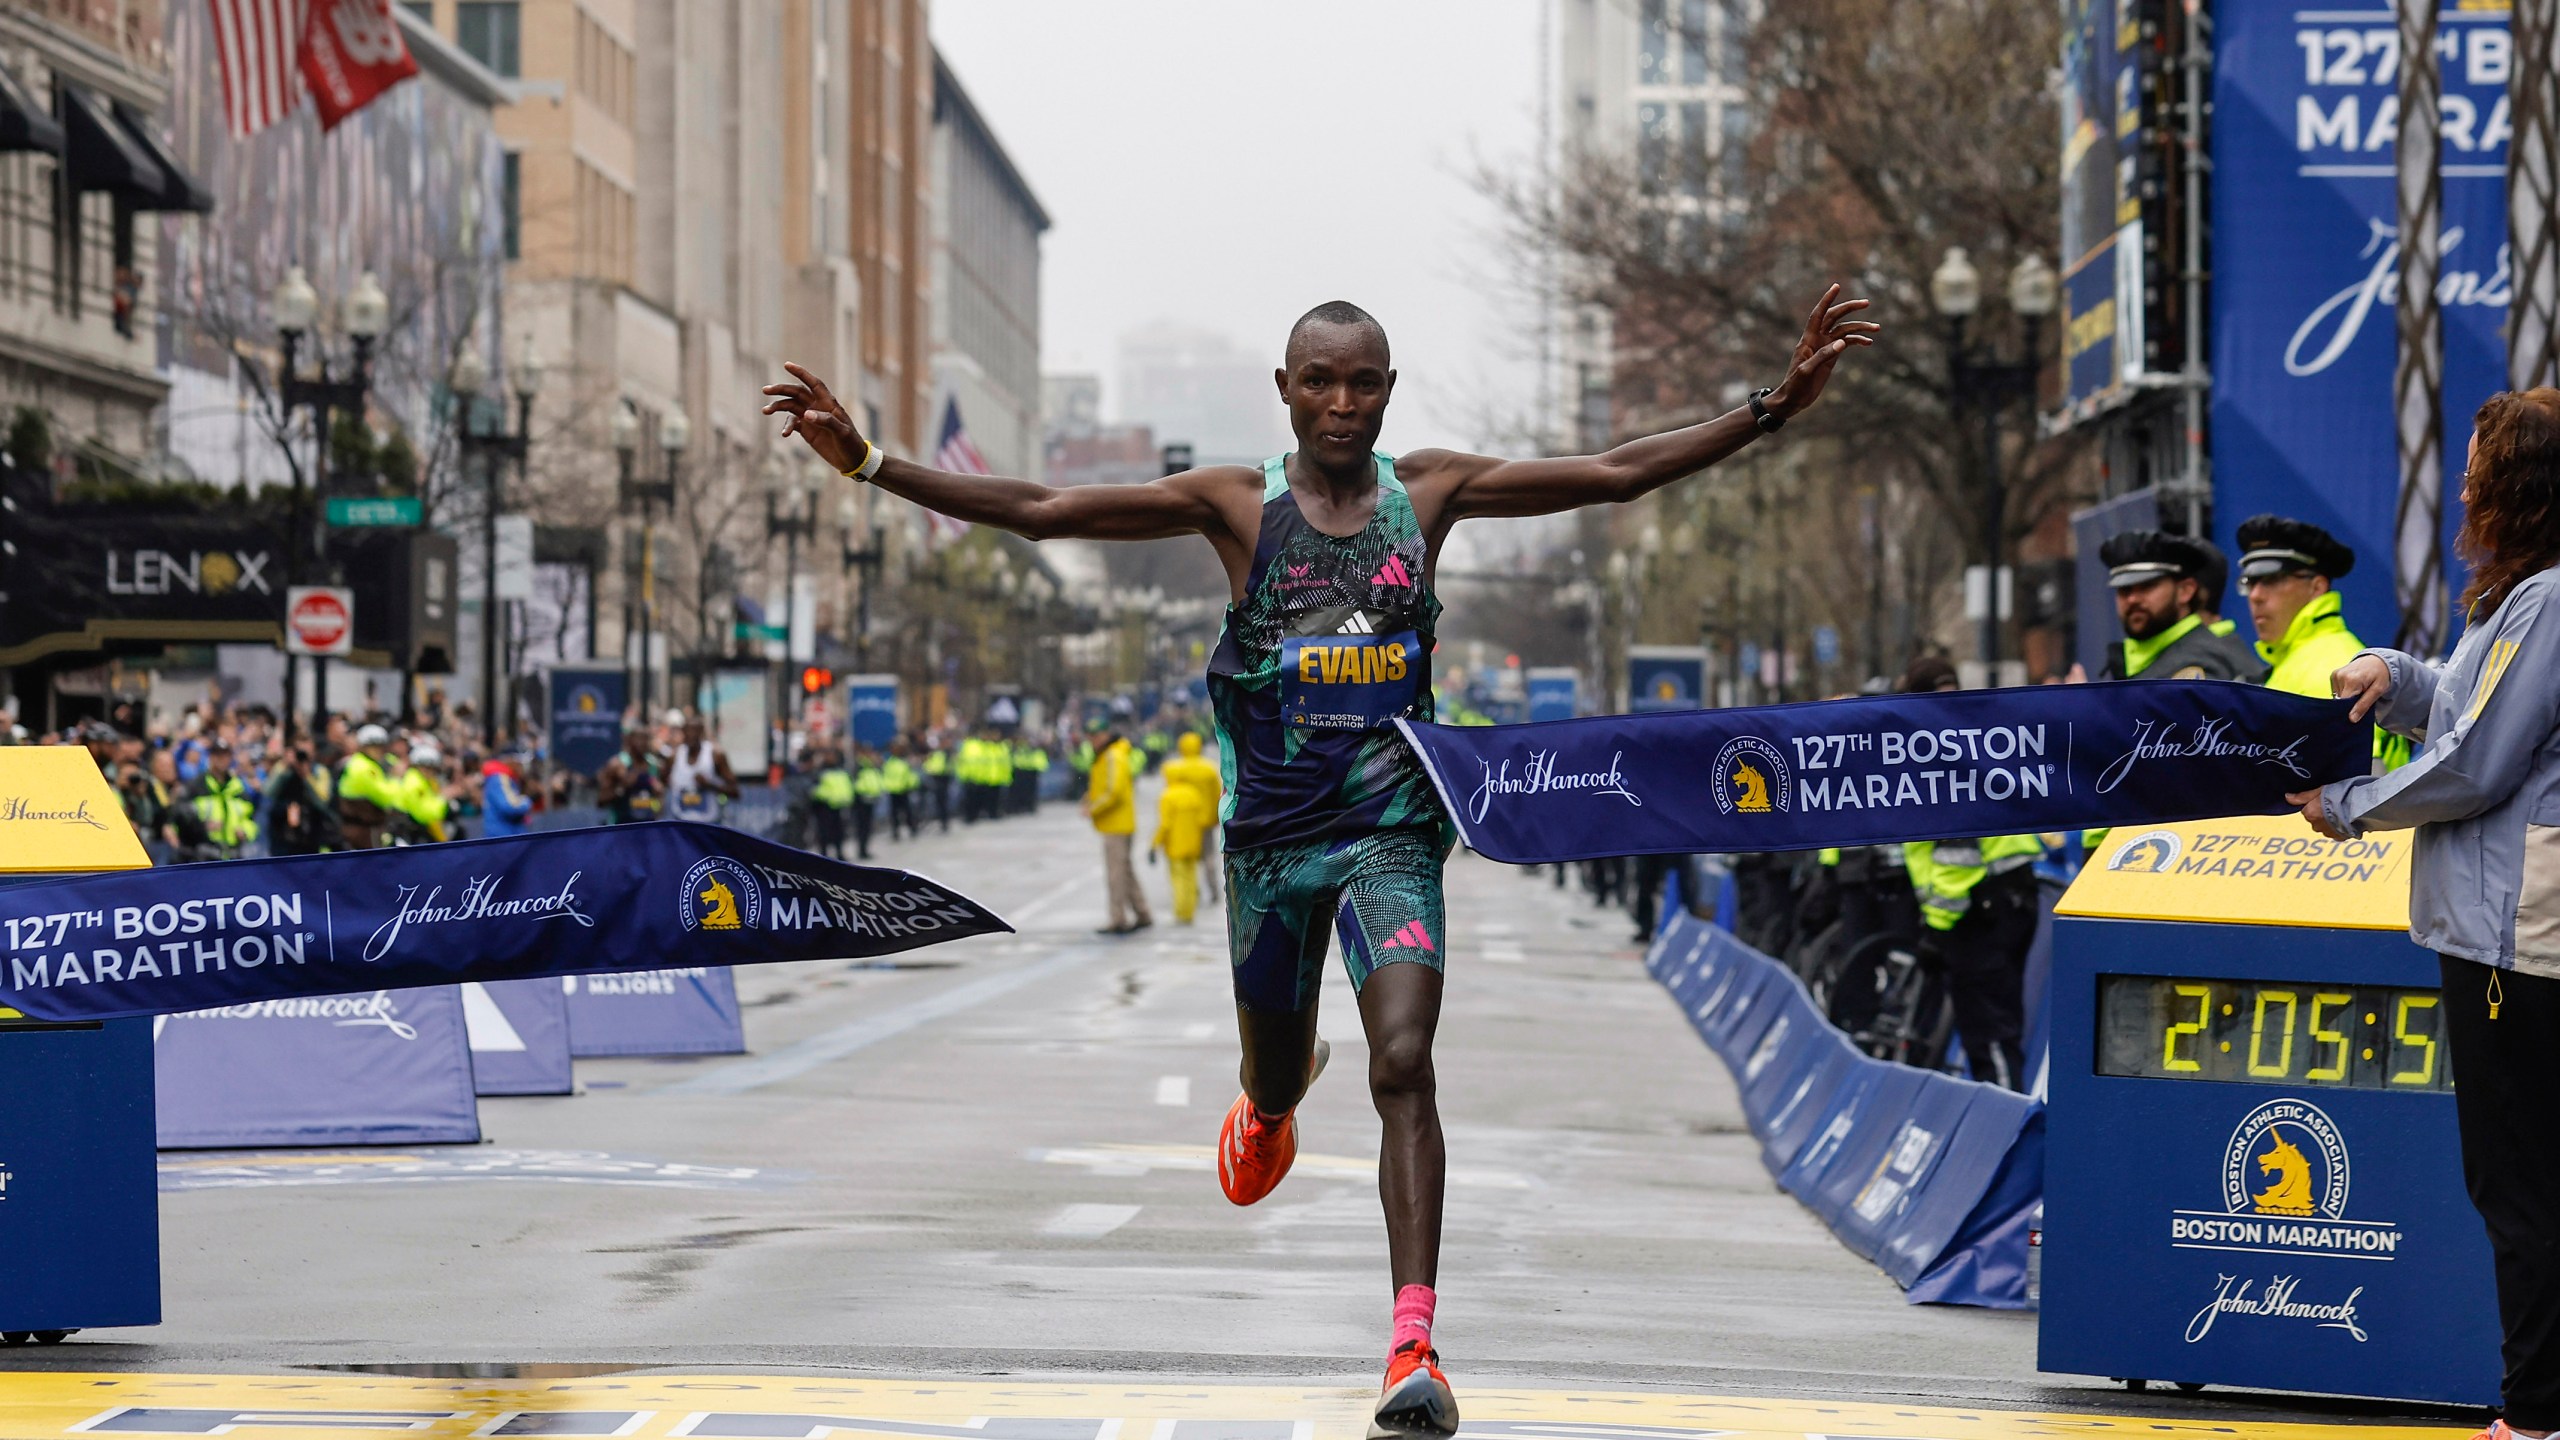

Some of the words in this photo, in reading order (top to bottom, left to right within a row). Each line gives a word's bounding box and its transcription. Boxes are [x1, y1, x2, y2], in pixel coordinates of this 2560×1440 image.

[2296, 94, 2513, 151] MARA
[1300, 577, 1330, 588] Angels
[1299, 642, 1407, 684] EVANS
[1309, 720, 1365, 729] MARATHON
[1329, 714, 1365, 722] BOSTON
[1720, 740, 1757, 765] ATHLETIC
[1791, 733, 1872, 770] 127TH
[1881, 724, 2046, 765] BOSTON
[2095, 718, 2182, 794] John
[2180, 715, 2312, 779] Hancock
[1469, 755, 1525, 825] John
[1715, 764, 1729, 809] BOSTON
[1757, 743, 1788, 807] ASSOCIATION
[0, 796, 109, 831] Hancock
[2190, 834, 2262, 854] 127TH
[2260, 837, 2393, 860] BOSTON
[682, 881, 694, 926] BOSTON
[726, 863, 758, 925] ASSOCIATION
[814, 878, 946, 912] BOSTON
[4, 909, 103, 951] 127TH
[114, 893, 303, 941] BOSTON
[363, 884, 451, 962] John
[770, 896, 977, 939] MARATHON
[587, 976, 677, 996] MAJORS
[2163, 984, 2455, 1085] 2:05:5
[2229, 1136, 2249, 1206] BOSTON
[2244, 1105, 2305, 1140] ATHLETIC
[2303, 1112, 2345, 1212] ASSOCIATION
[2171, 1218, 2262, 1244] BOSTON
[2184, 1272, 2258, 1343] John
[545, 1383, 1210, 1400] BOSTON
